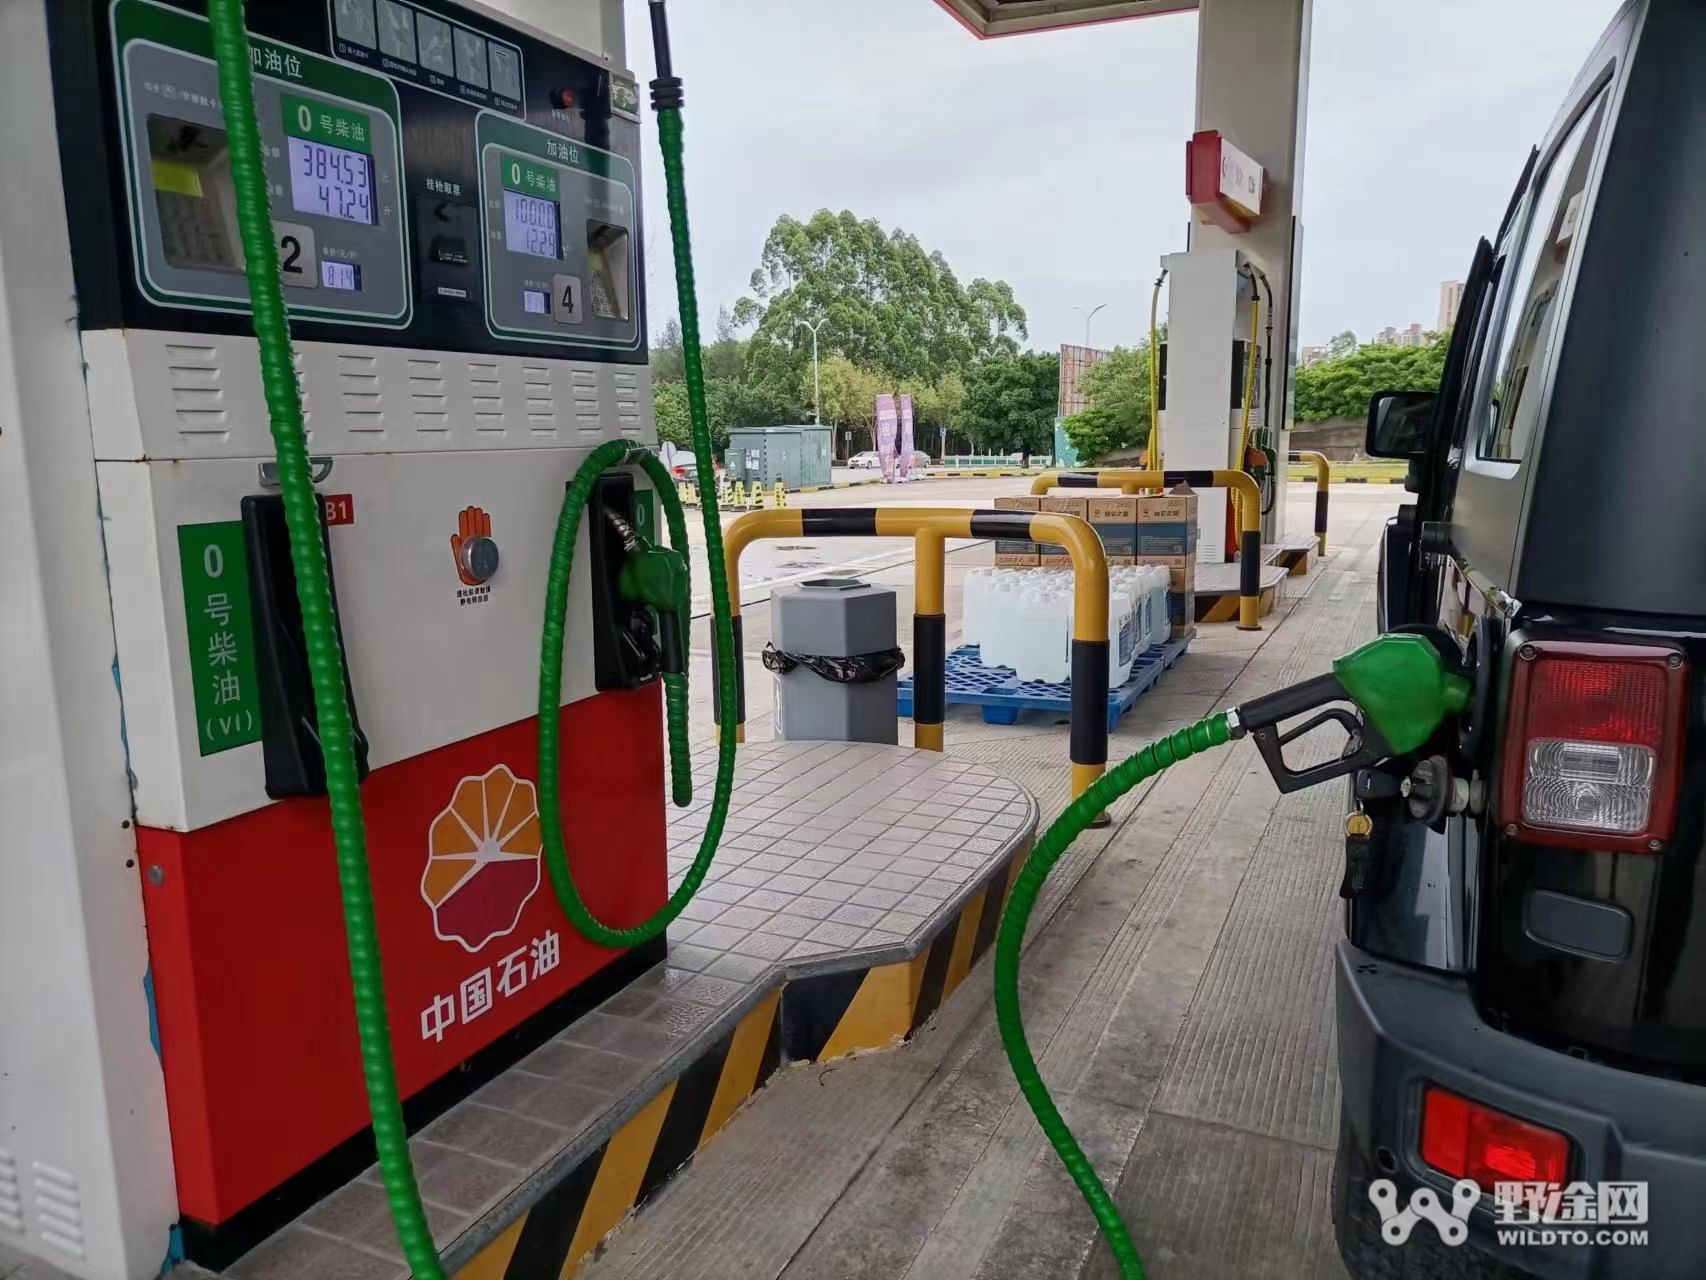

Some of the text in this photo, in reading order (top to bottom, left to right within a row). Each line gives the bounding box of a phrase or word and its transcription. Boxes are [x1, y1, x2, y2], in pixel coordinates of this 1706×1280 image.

[298, 105, 365, 142] 0 号柴油
[304, 144, 367, 189] 384.53
[546, 140, 579, 164] 加油位
[511, 163, 521, 185] 0
[319, 184, 369, 219] 47.24
[281, 236, 303, 274] 2
[562, 286, 574, 314] 4
[325, 500, 347, 520] B1
[204, 544, 240, 704] 0 号柴油
[421, 929, 560, 1043] 中国石油
